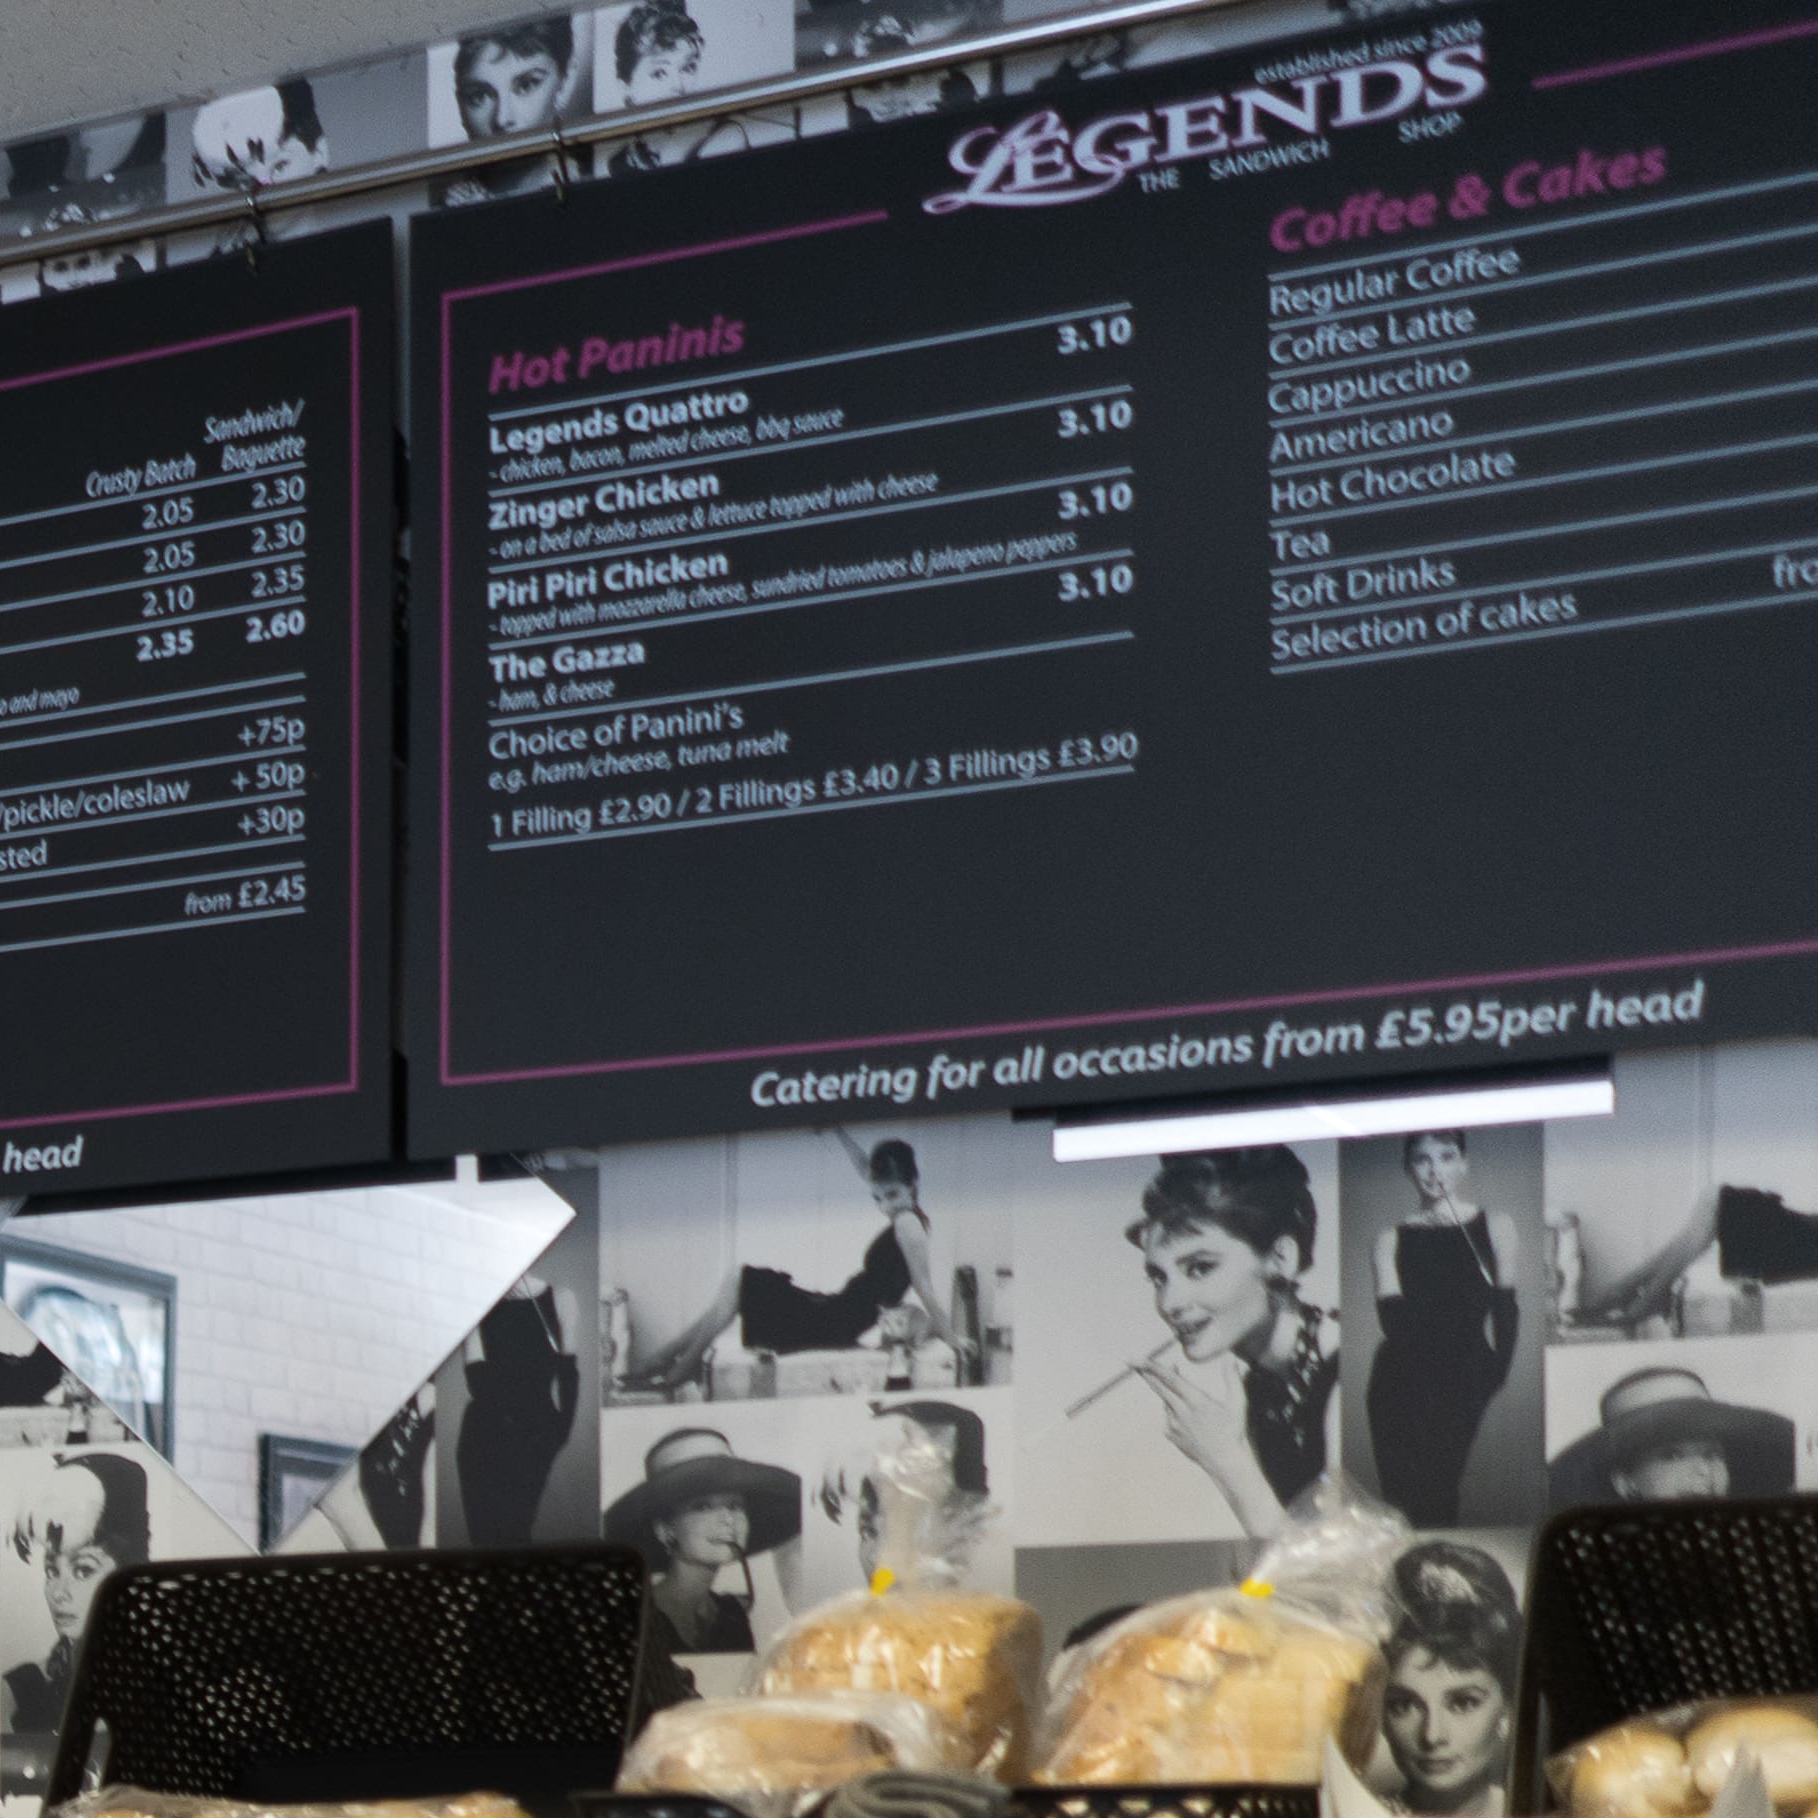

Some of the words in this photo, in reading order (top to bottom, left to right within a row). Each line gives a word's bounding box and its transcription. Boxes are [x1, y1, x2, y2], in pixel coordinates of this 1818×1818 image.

[922, 45, 1486, 216] LEGENDS
[1137, 166, 1179, 193] THE
[1208, 137, 1330, 180] SANDWICH
[1397, 110, 1462, 143] SHOP
[1269, 190, 1438, 252] Coffee
[1447, 172, 1491, 219] &
[1501, 146, 1665, 208] Cakes
[1268, 267, 1399, 316] Regular
[1404, 246, 1520, 291] Coffee
[488, 346, 571, 394] Hot
[577, 314, 744, 378] Paninis
[1268, 321, 1380, 365] Coffee
[1386, 306, 1476, 345] Latte
[489, 407, 619, 454] Legends
[623, 390, 749, 432] Quattro
[1056, 314, 1132, 355] 3.10
[1267, 357, 1471, 414] Cappuccino
[487, 494, 590, 531] Zinger
[593, 473, 720, 513] Chicken
[1057, 398, 1133, 438] 3.10
[1268, 410, 1454, 463] Americano
[1270, 477, 1333, 513] Hot
[1339, 450, 1516, 501] Chocolate
[486, 574, 539, 610] Piri
[544, 565, 597, 601] Piri
[602, 552, 728, 591] Chicken
[1057, 480, 1133, 520] 3.10
[1268, 528, 1331, 562] Tea
[1270, 571, 1338, 611] Soft
[1345, 555, 1456, 600] Drinks
[135, 627, 194, 662] 2.35
[245, 608, 306, 643] 2.60
[487, 652, 547, 683] The
[551, 641, 645, 674] Gazza
[1057, 563, 1133, 602] 3.10
[1270, 615, 1428, 661] Selection
[1434, 599, 1474, 637] of
[1478, 590, 1578, 631] cakes
[487, 725, 588, 760] Choice
[592, 713, 626, 746] of
[630, 701, 744, 742] Panini's
[487, 767, 527, 794] e.g.
[530, 749, 672, 785] ham/cheese,
[676, 740, 733, 766] tuna
[734, 728, 790, 758] melt
[255, 759, 306, 792] 50p
[491, 812, 502, 838] 1
[511, 804, 592, 835] Filling
[597, 791, 672, 826] £2.90
[694, 786, 713, 814] 2
[718, 778, 816, 810] Fillings
[822, 762, 900, 798] £3.40
[923, 756, 942, 785] 3
[948, 747, 1051, 781] Fillings
[1057, 730, 1139, 768] £3.90
[237, 804, 305, 836] +30p
[183, 891, 232, 915] from
[237, 873, 306, 908] £2.45
[749, 1063, 918, 1107] Catering
[925, 1053, 986, 1100] for
[992, 1044, 1045, 1086] all
[1051, 1033, 1254, 1080] occasions
[1261, 1019, 1365, 1069] from
[1585, 978, 1705, 1029] head
